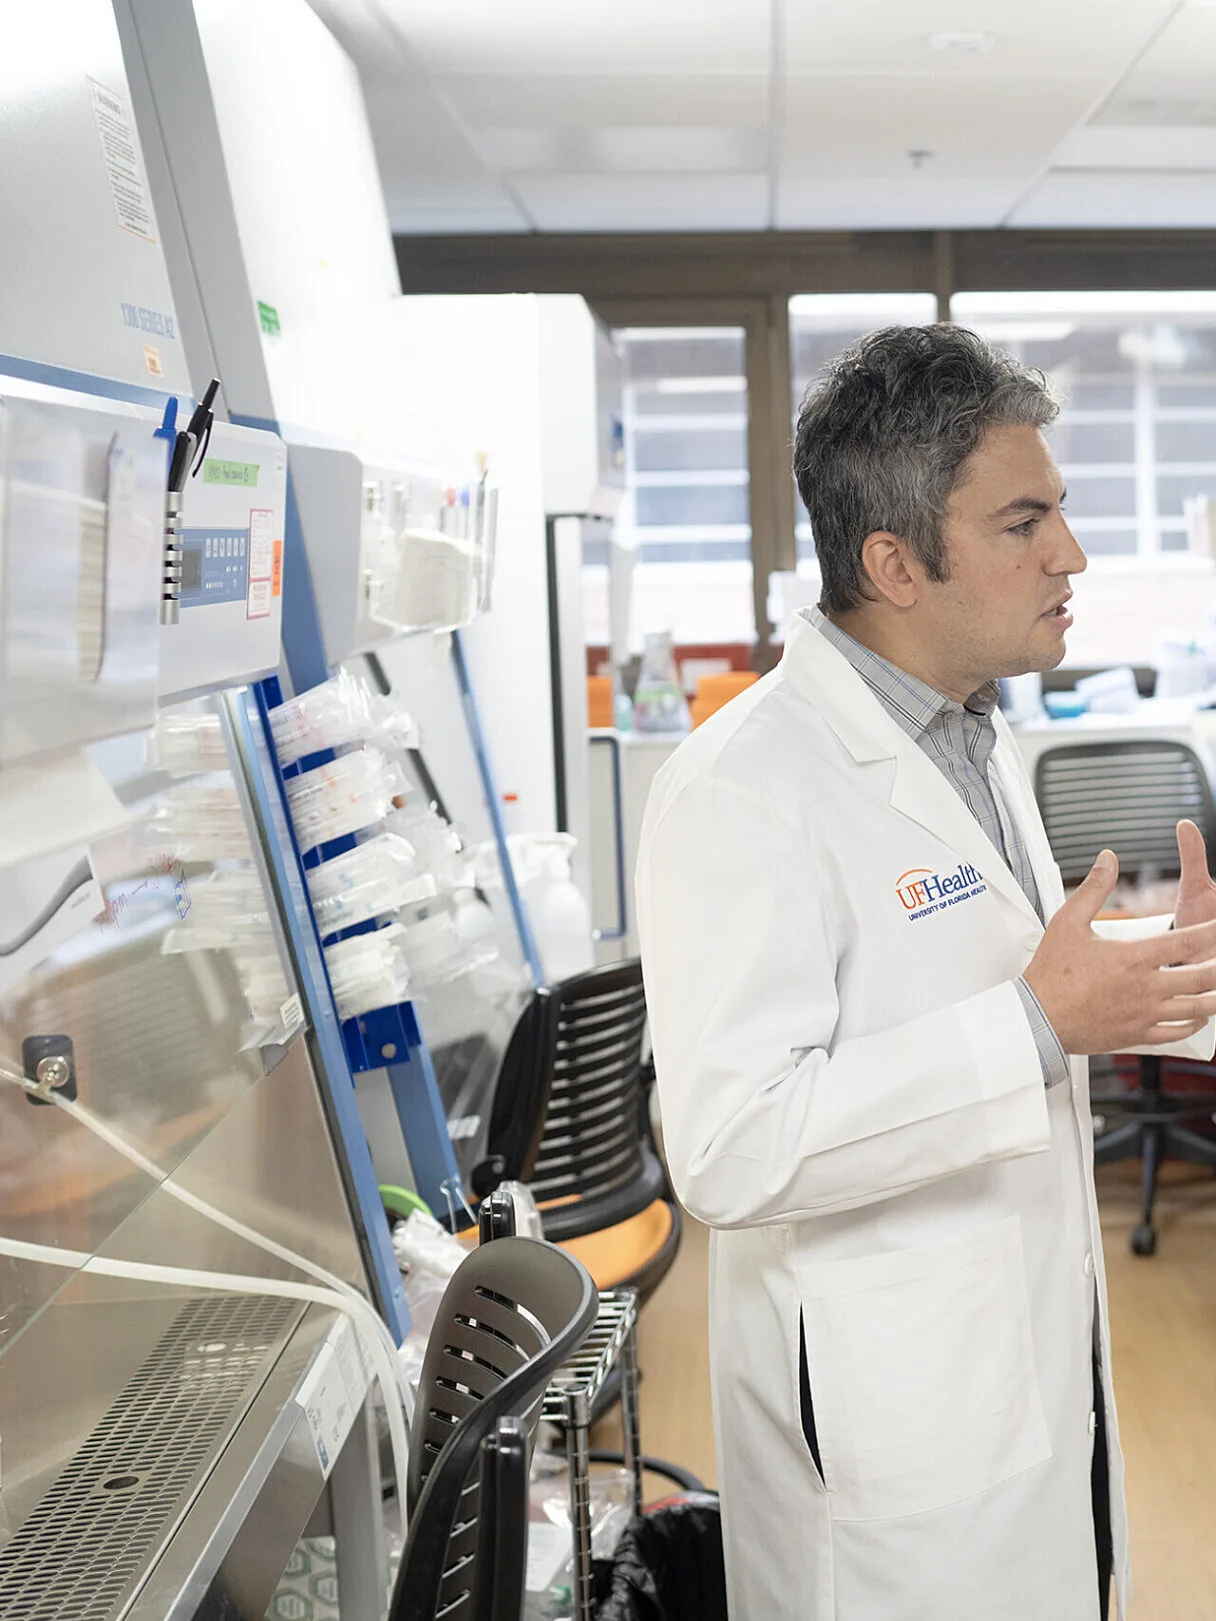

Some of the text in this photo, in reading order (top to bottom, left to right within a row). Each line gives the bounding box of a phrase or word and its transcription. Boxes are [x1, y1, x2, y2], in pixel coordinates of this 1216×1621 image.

[908, 904, 939, 921] UNIVERSITY
[939, 901, 947, 910] OF
[948, 892, 971, 906] FLORIDA
